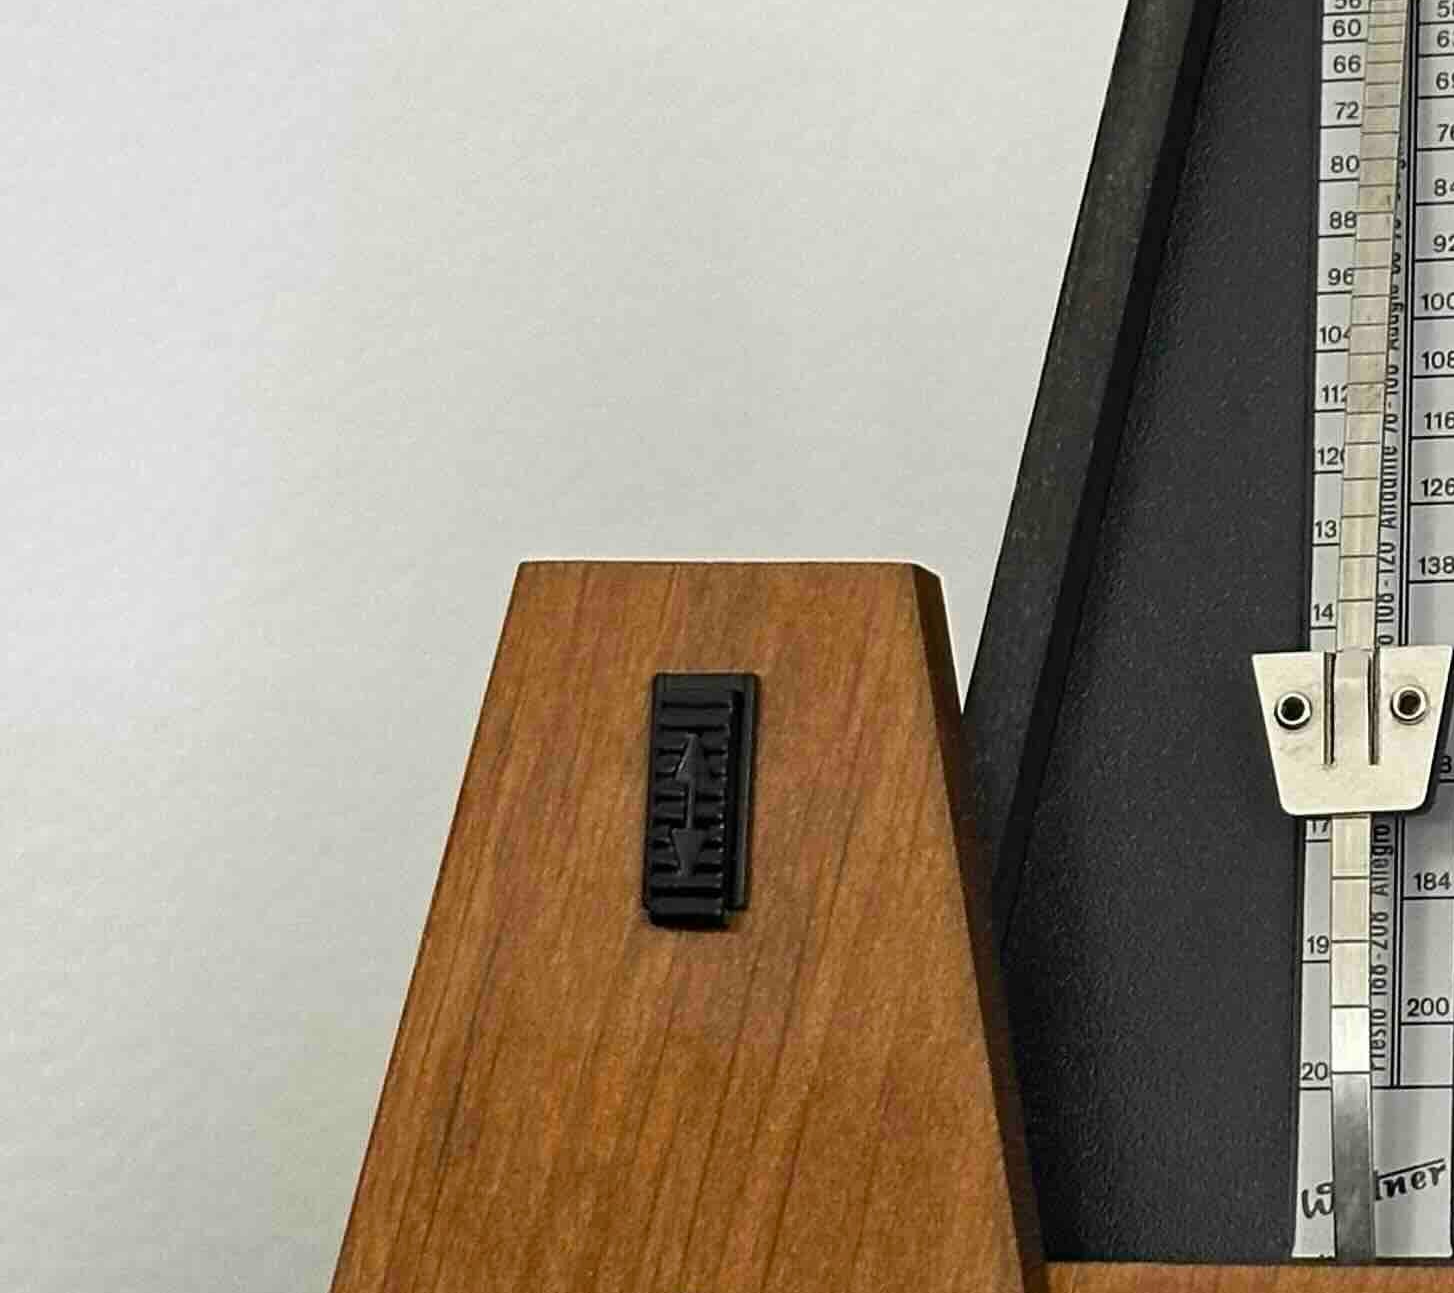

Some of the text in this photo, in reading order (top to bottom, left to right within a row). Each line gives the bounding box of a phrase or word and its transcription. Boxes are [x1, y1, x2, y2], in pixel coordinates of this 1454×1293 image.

[1332, 18, 1361, 37] 60
[1333, 55, 1361, 73] 66
[1335, 102, 1359, 120] 72
[1330, 156, 1360, 173] 80
[1329, 212, 1357, 229] 88
[1315, 520, 1337, 538] 13
[1314, 604, 1333, 621] 14
[1413, 872, 1451, 890] 184
[1307, 936, 1329, 954] 19
[1407, 998, 1449, 1017] 200
[1302, 1063, 1328, 1081] 20
